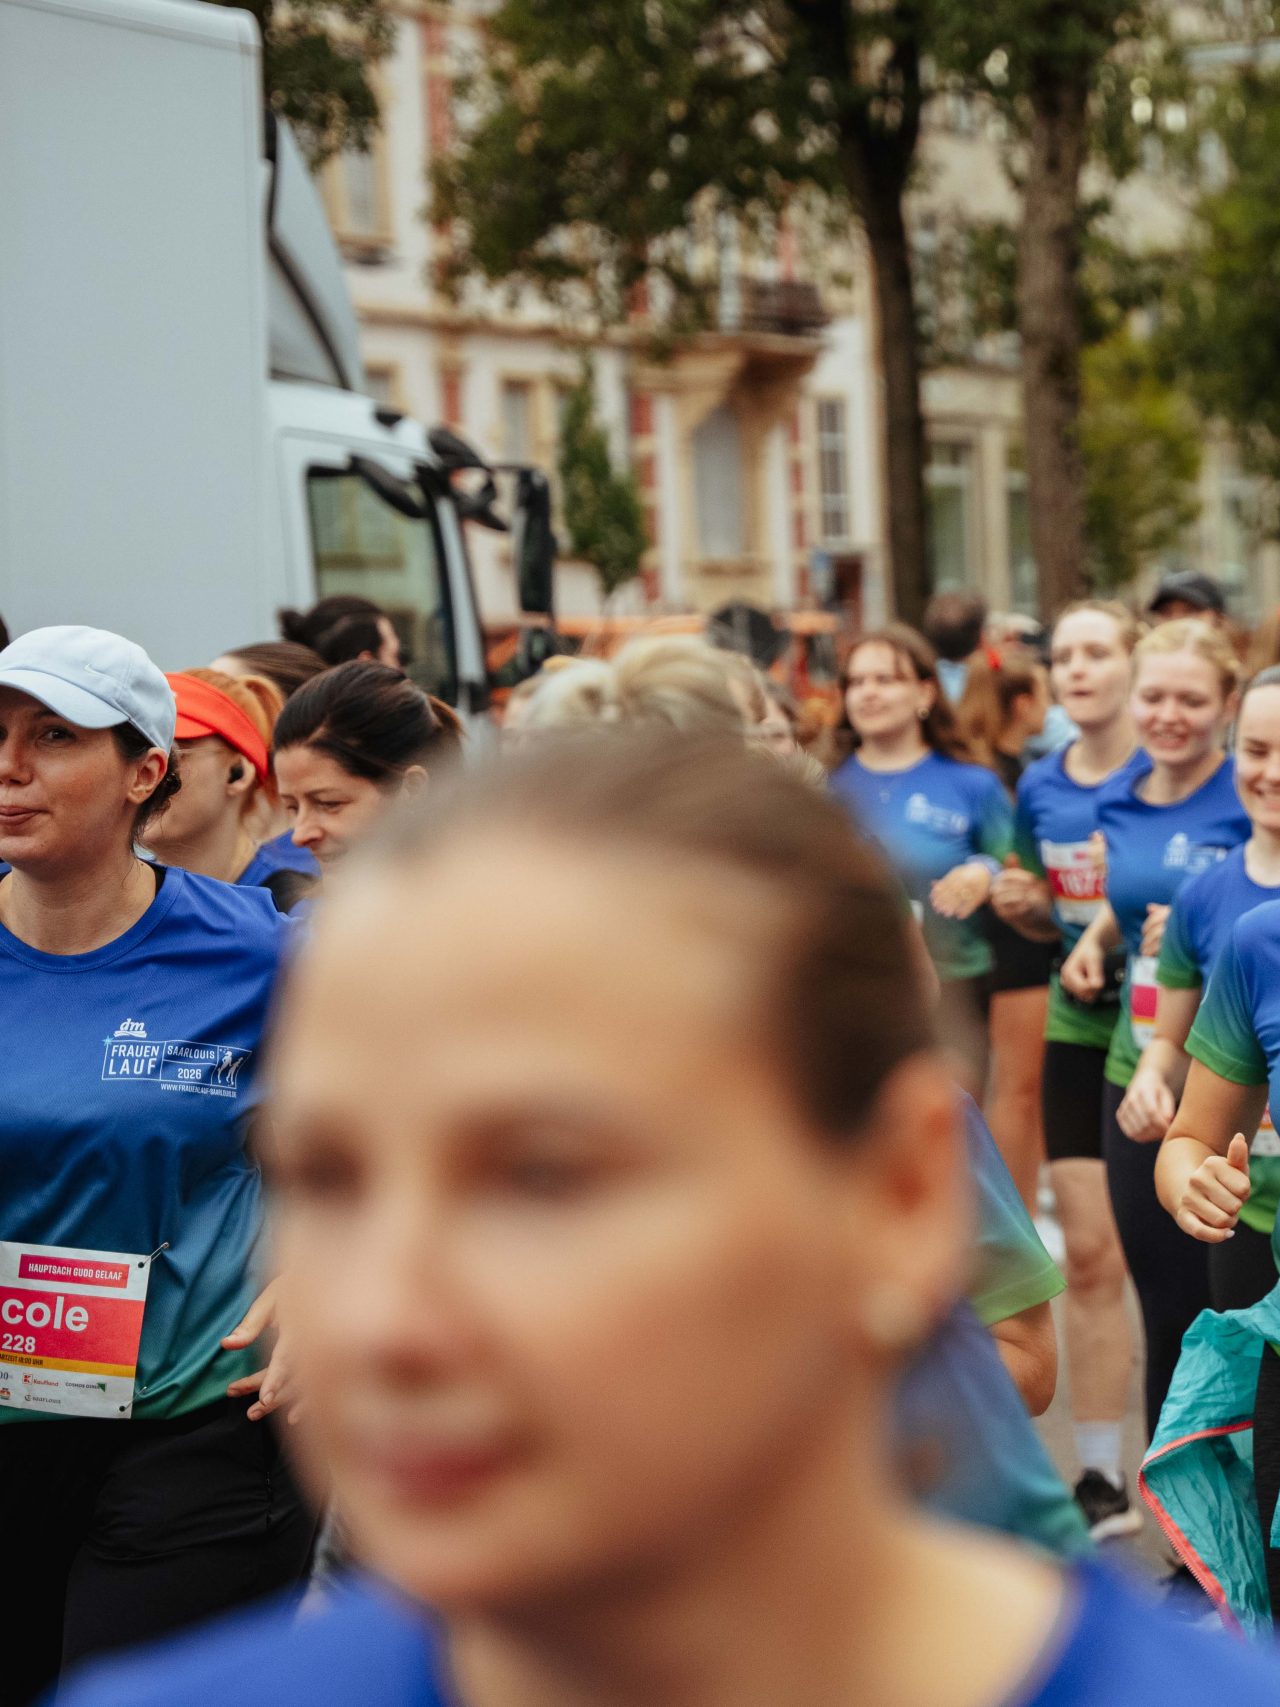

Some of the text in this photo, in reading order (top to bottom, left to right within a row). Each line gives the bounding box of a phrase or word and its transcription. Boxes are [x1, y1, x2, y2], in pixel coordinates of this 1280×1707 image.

[111, 1045, 160, 1058] FRAUEN
[167, 1045, 215, 1060] SAARLOUIS
[108, 1058, 157, 1075] LAUF
[177, 1068, 202, 1080] 2026
[28, 1263, 123, 1281] HAUPTSACH GUDD GELAAF
[1, 1296, 89, 1332] cole
[2, 1333, 36, 1353] 228
[33, 1379, 59, 1387] Kaufland
